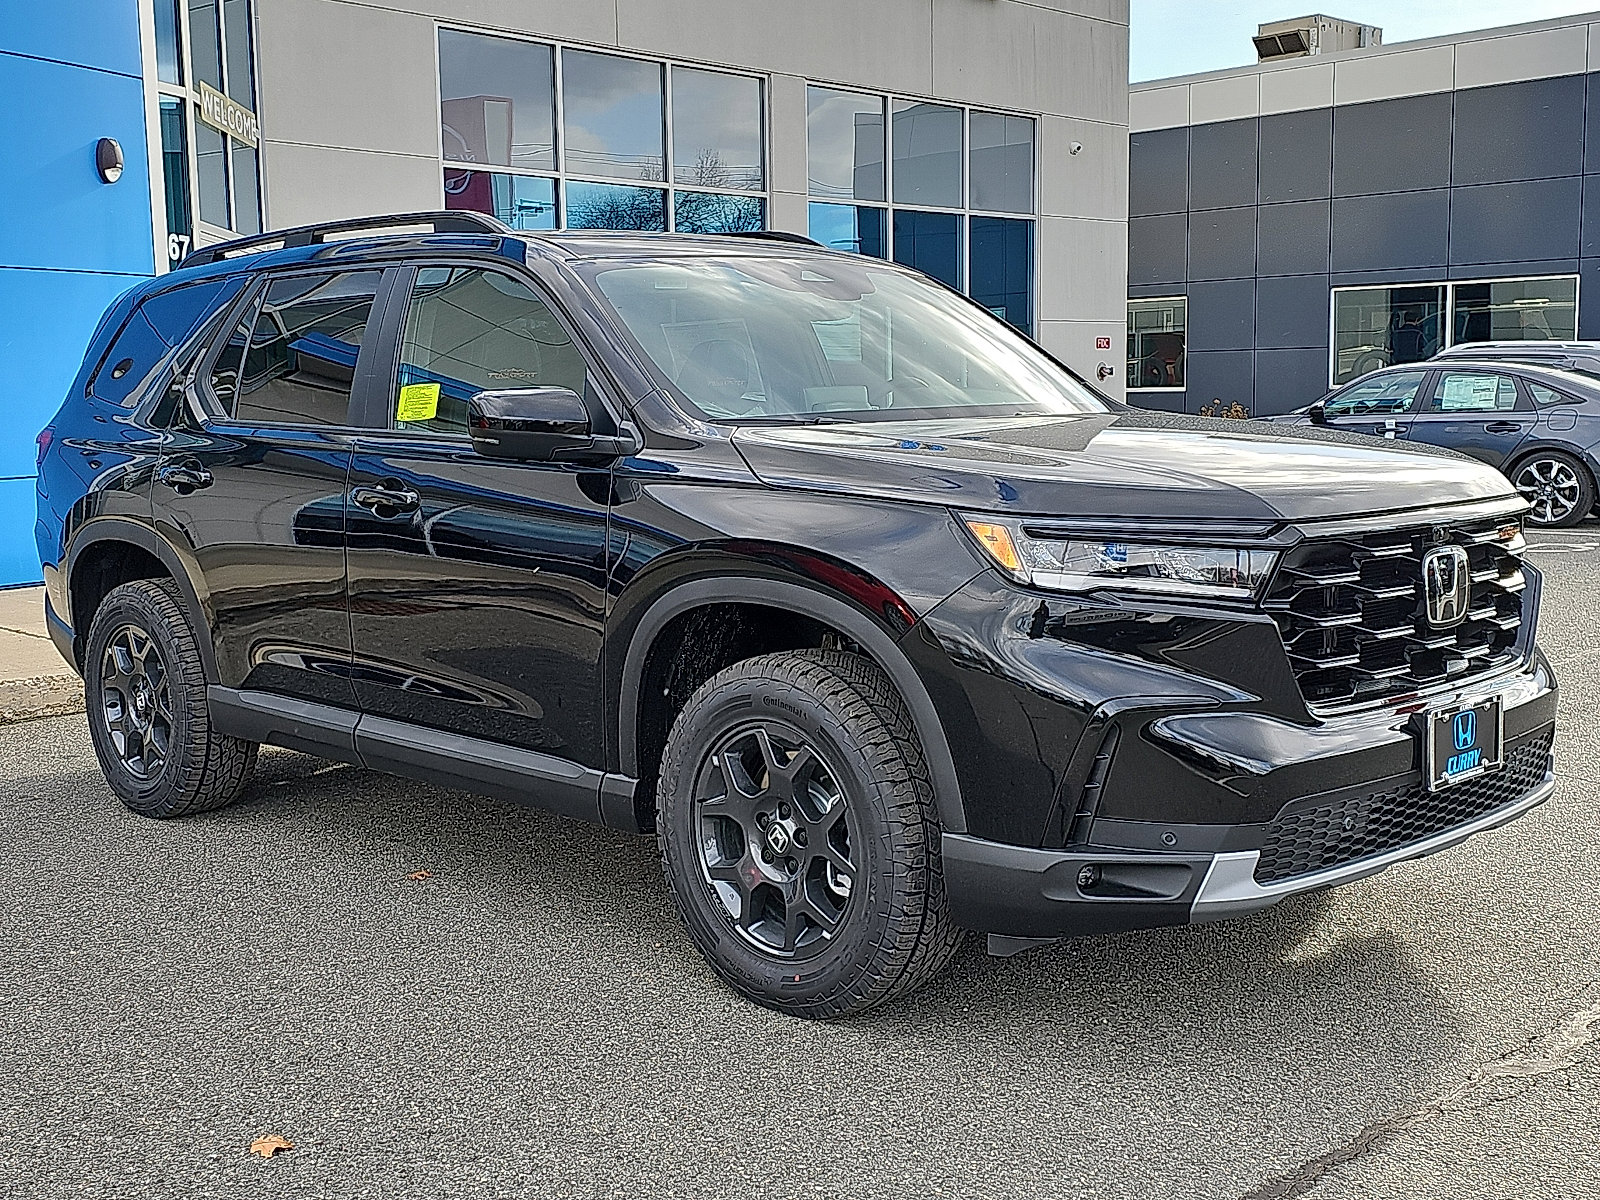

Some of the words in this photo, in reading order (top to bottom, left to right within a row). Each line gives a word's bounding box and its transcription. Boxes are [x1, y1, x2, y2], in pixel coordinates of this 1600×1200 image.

[202, 89, 257, 143] WELCOME
[168, 233, 190, 261] 67
[1097, 338, 1109, 348] FDC
[762, 695, 803, 718] Continental
[1447, 747, 1482, 775] CURRY
